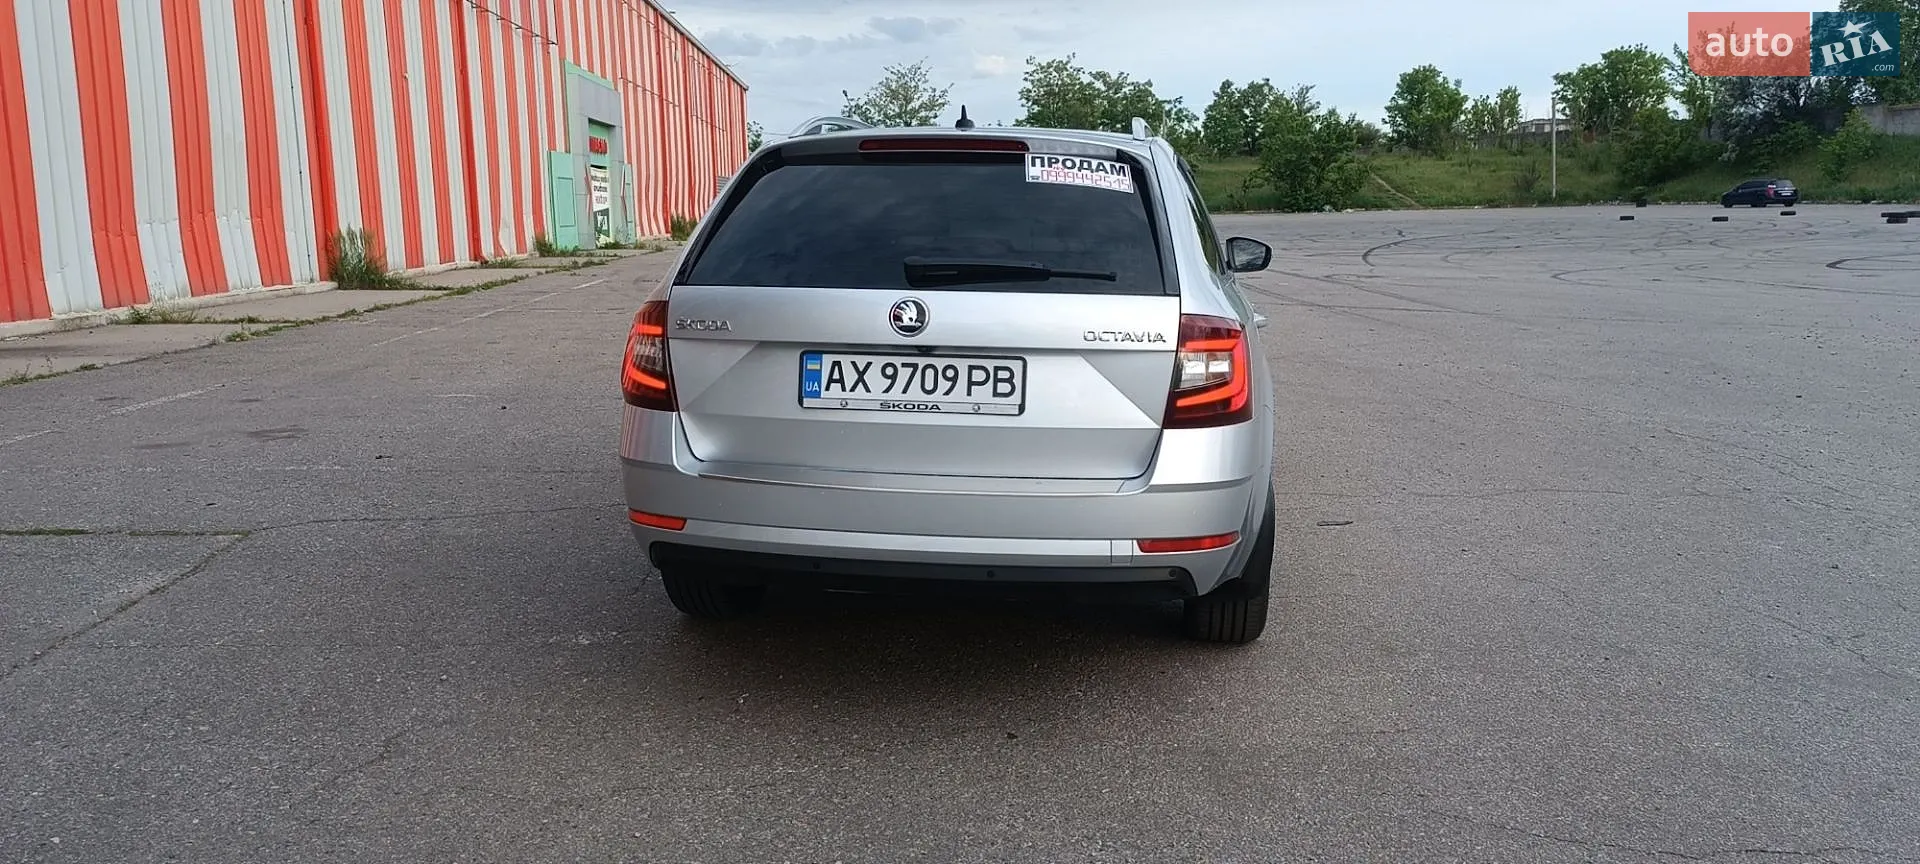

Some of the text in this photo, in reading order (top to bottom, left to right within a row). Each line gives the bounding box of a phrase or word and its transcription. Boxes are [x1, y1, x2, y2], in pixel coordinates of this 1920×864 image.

[1030, 155, 1127, 178] ПРОДАМ
[1083, 330, 1167, 343] OCTAVIA
[805, 380, 820, 392] UA
[824, 360, 1017, 399] AX 9709 PB
